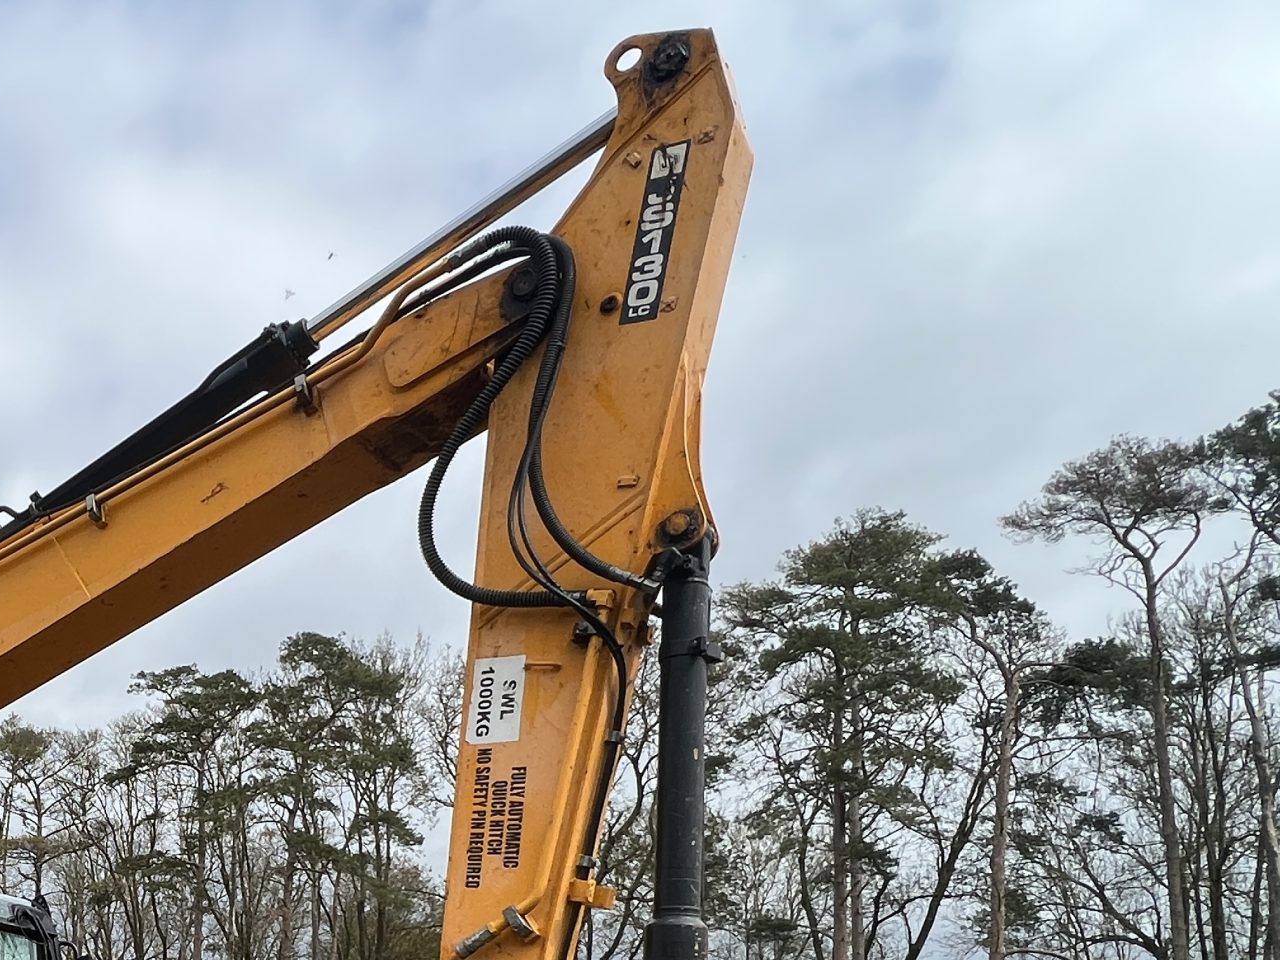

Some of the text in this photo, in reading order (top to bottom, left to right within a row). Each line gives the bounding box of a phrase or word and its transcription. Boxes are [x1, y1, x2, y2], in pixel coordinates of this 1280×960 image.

[475, 666, 495, 738] 1000KG
[499, 680, 517, 720] SWL
[465, 748, 492, 888] NO SAFETY PIN REQUIRED
[487, 780, 508, 855] QUICK HITCH
[503, 766, 527, 868] FULLY AUTOMATIC
